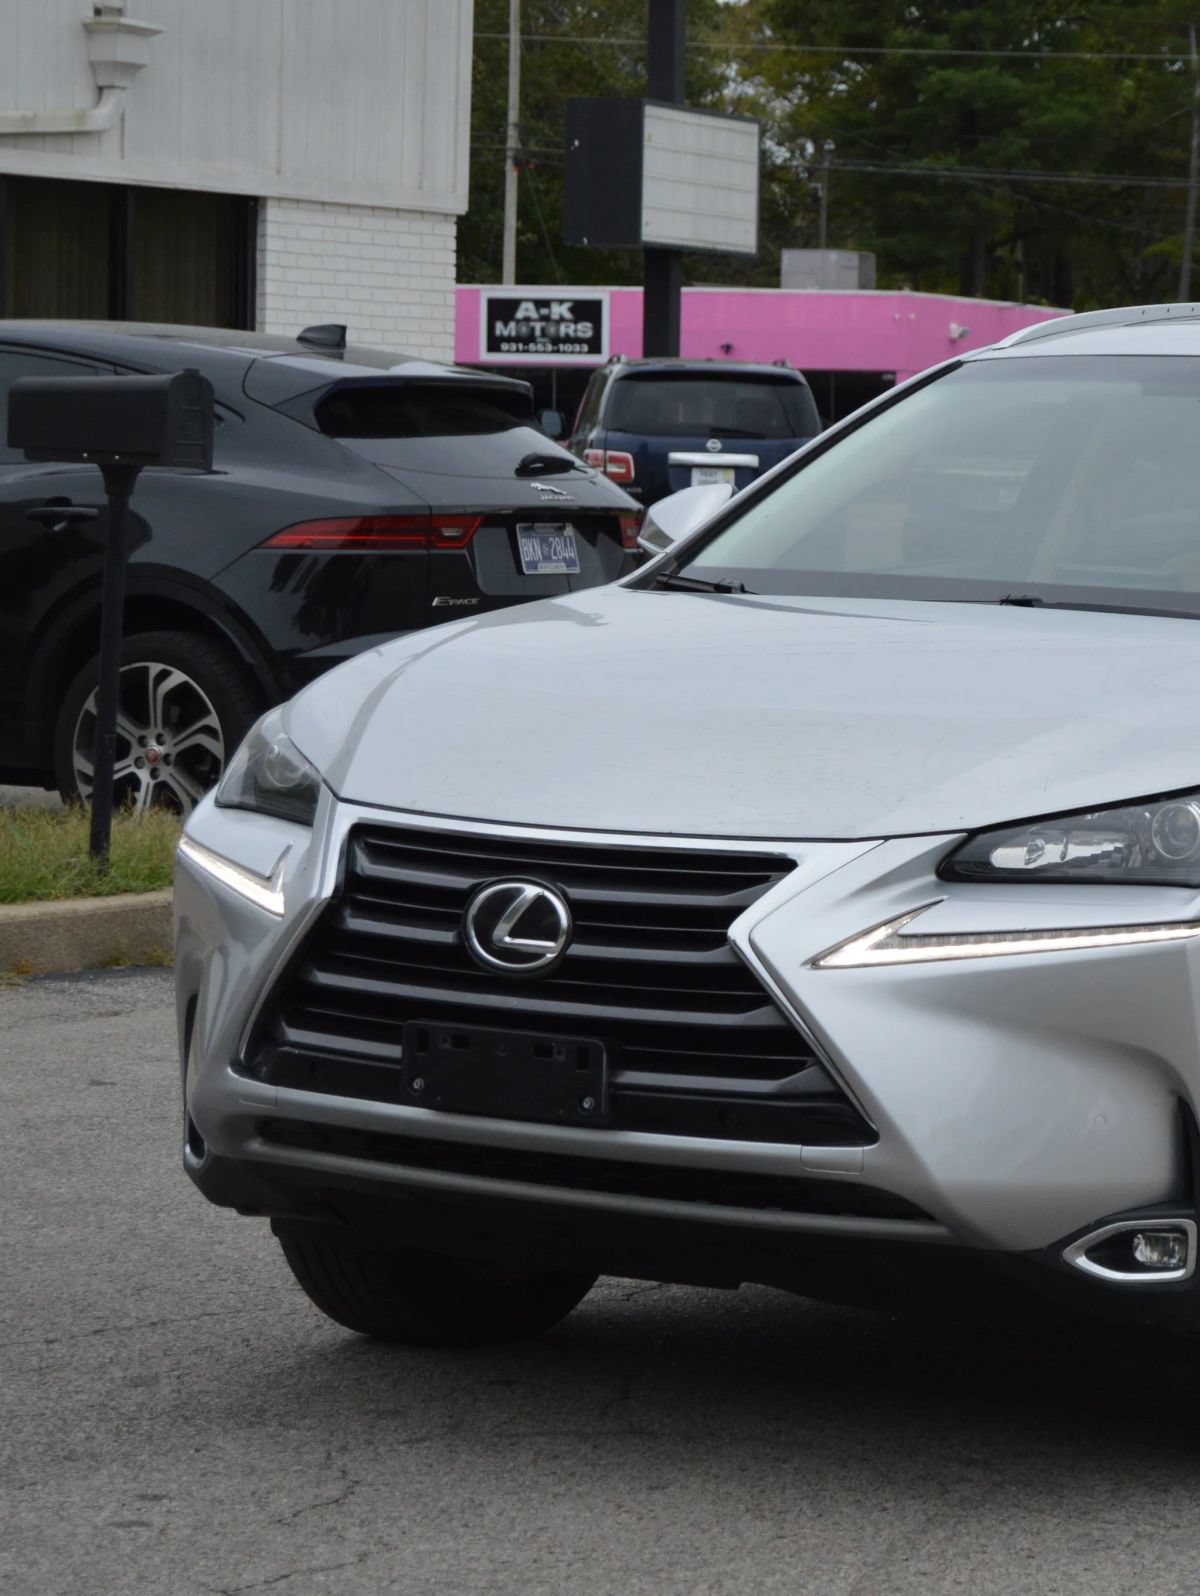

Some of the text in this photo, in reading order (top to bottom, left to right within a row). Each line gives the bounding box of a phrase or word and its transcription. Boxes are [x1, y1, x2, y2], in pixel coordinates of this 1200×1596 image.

[514, 301, 574, 320] A-K
[494, 321, 594, 338] MOTORS
[521, 536, 576, 561] BKN 2844
